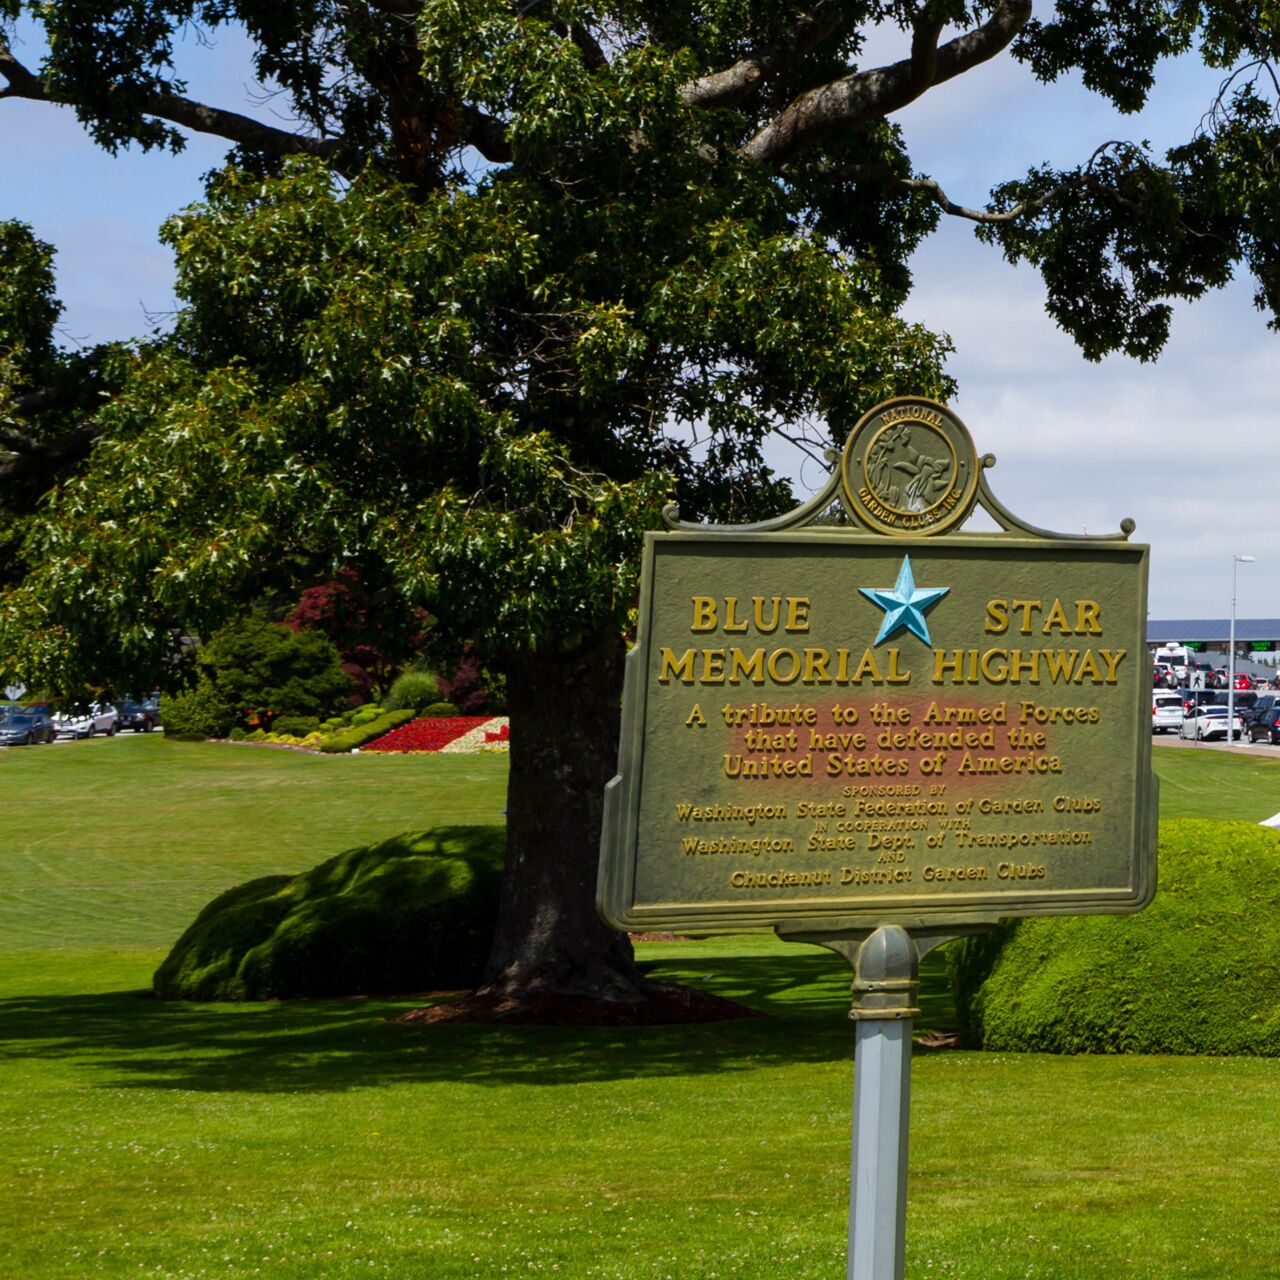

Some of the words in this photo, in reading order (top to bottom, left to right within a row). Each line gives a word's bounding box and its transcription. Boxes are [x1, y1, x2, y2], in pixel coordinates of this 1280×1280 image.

[881, 406, 942, 426] NATIONAL
[859, 488, 896, 524] GARDEN
[902, 509, 941, 526] CLUBS
[690, 597, 810, 631] BLUE
[984, 598, 1103, 633] STAR
[658, 648, 911, 683] MEMORIAL
[931, 648, 1127, 683] HIGHWAY
[686, 703, 707, 725] A
[722, 703, 817, 724] tribute
[832, 704, 858, 724] to
[870, 703, 910, 724] the
[924, 702, 1007, 723] Armed
[1020, 701, 1099, 722] Forces
[744, 729, 798, 750] that
[809, 728, 866, 749] have
[877, 726, 994, 748] defended
[1008, 728, 1046, 747] the
[723, 754, 812, 776] United
[827, 753, 909, 774] States
[919, 752, 947, 773] of
[958, 752, 1062, 773] America
[843, 785, 921, 797] SPONSORED
[930, 785, 946, 796] BY
[676, 802, 787, 824] Washington
[797, 801, 846, 818] State
[855, 799, 948, 817] Federation
[956, 798, 974, 814] of
[979, 798, 1044, 814] Garden
[1053, 796, 1101, 812] Clubs
[815, 822, 828, 833] IN
[837, 819, 928, 832] COOPERATION
[939, 819, 971, 830] WITH
[682, 836, 794, 855] Washington
[808, 834, 856, 852] State
[867, 833, 915, 851] Dept.
[926, 832, 945, 848] of
[955, 829, 1093, 850] Transportation
[878, 852, 905, 863] AND
[731, 869, 832, 887] Chuckanut
[840, 866, 912, 884] District
[923, 866, 988, 882] Garden
[997, 863, 1045, 879] Clubs
